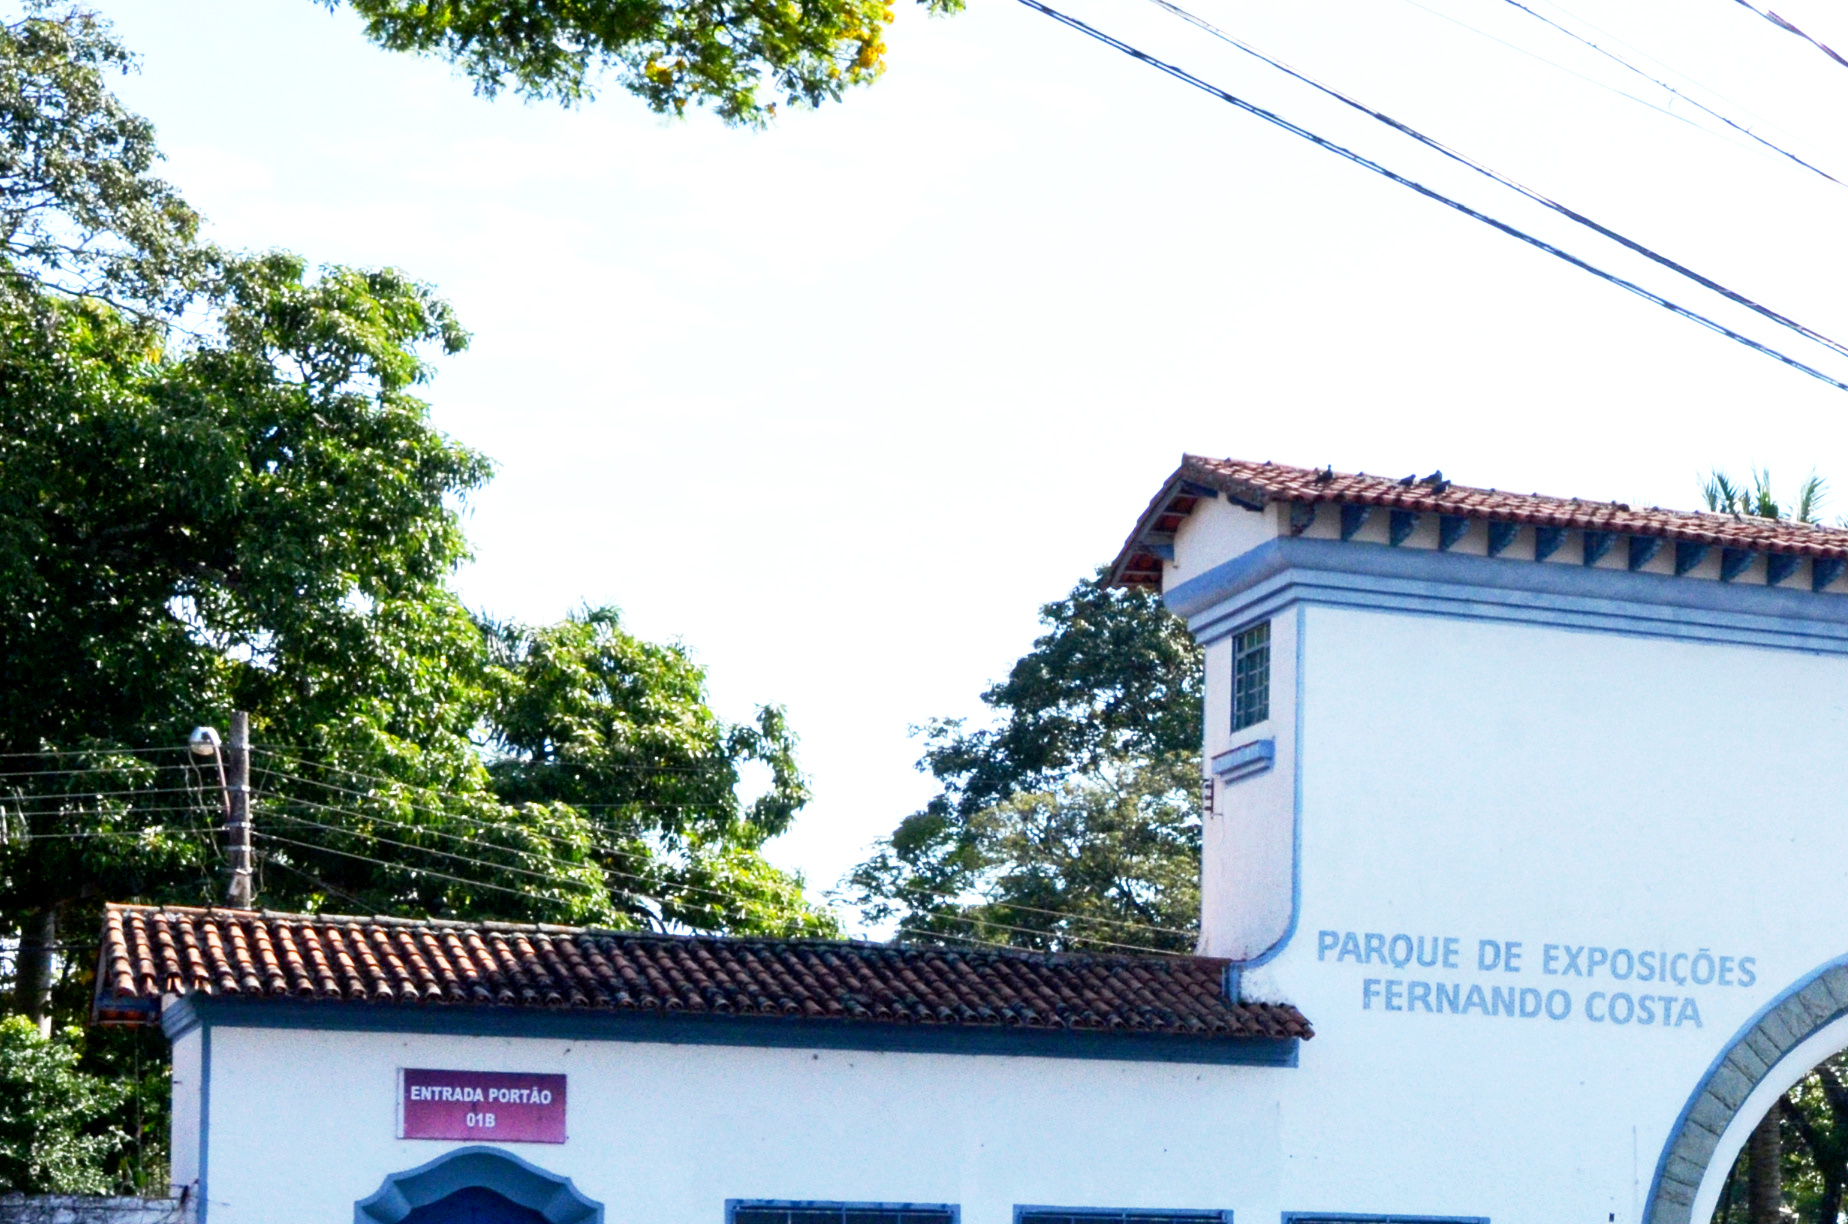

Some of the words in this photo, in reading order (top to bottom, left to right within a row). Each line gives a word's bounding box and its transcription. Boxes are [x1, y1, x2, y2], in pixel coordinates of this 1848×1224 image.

[1317, 929, 1461, 971] PARQUE
[1476, 938, 1524, 973] DE
[1542, 943, 1757, 988] EXPOSIÇÕES
[1361, 976, 1572, 1022] FERNANDO
[1584, 992, 1704, 1030] COSTA
[410, 1085, 484, 1102] ENTRADA
[488, 1086, 552, 1104] PORTÃO
[466, 1112, 496, 1128] 01B
